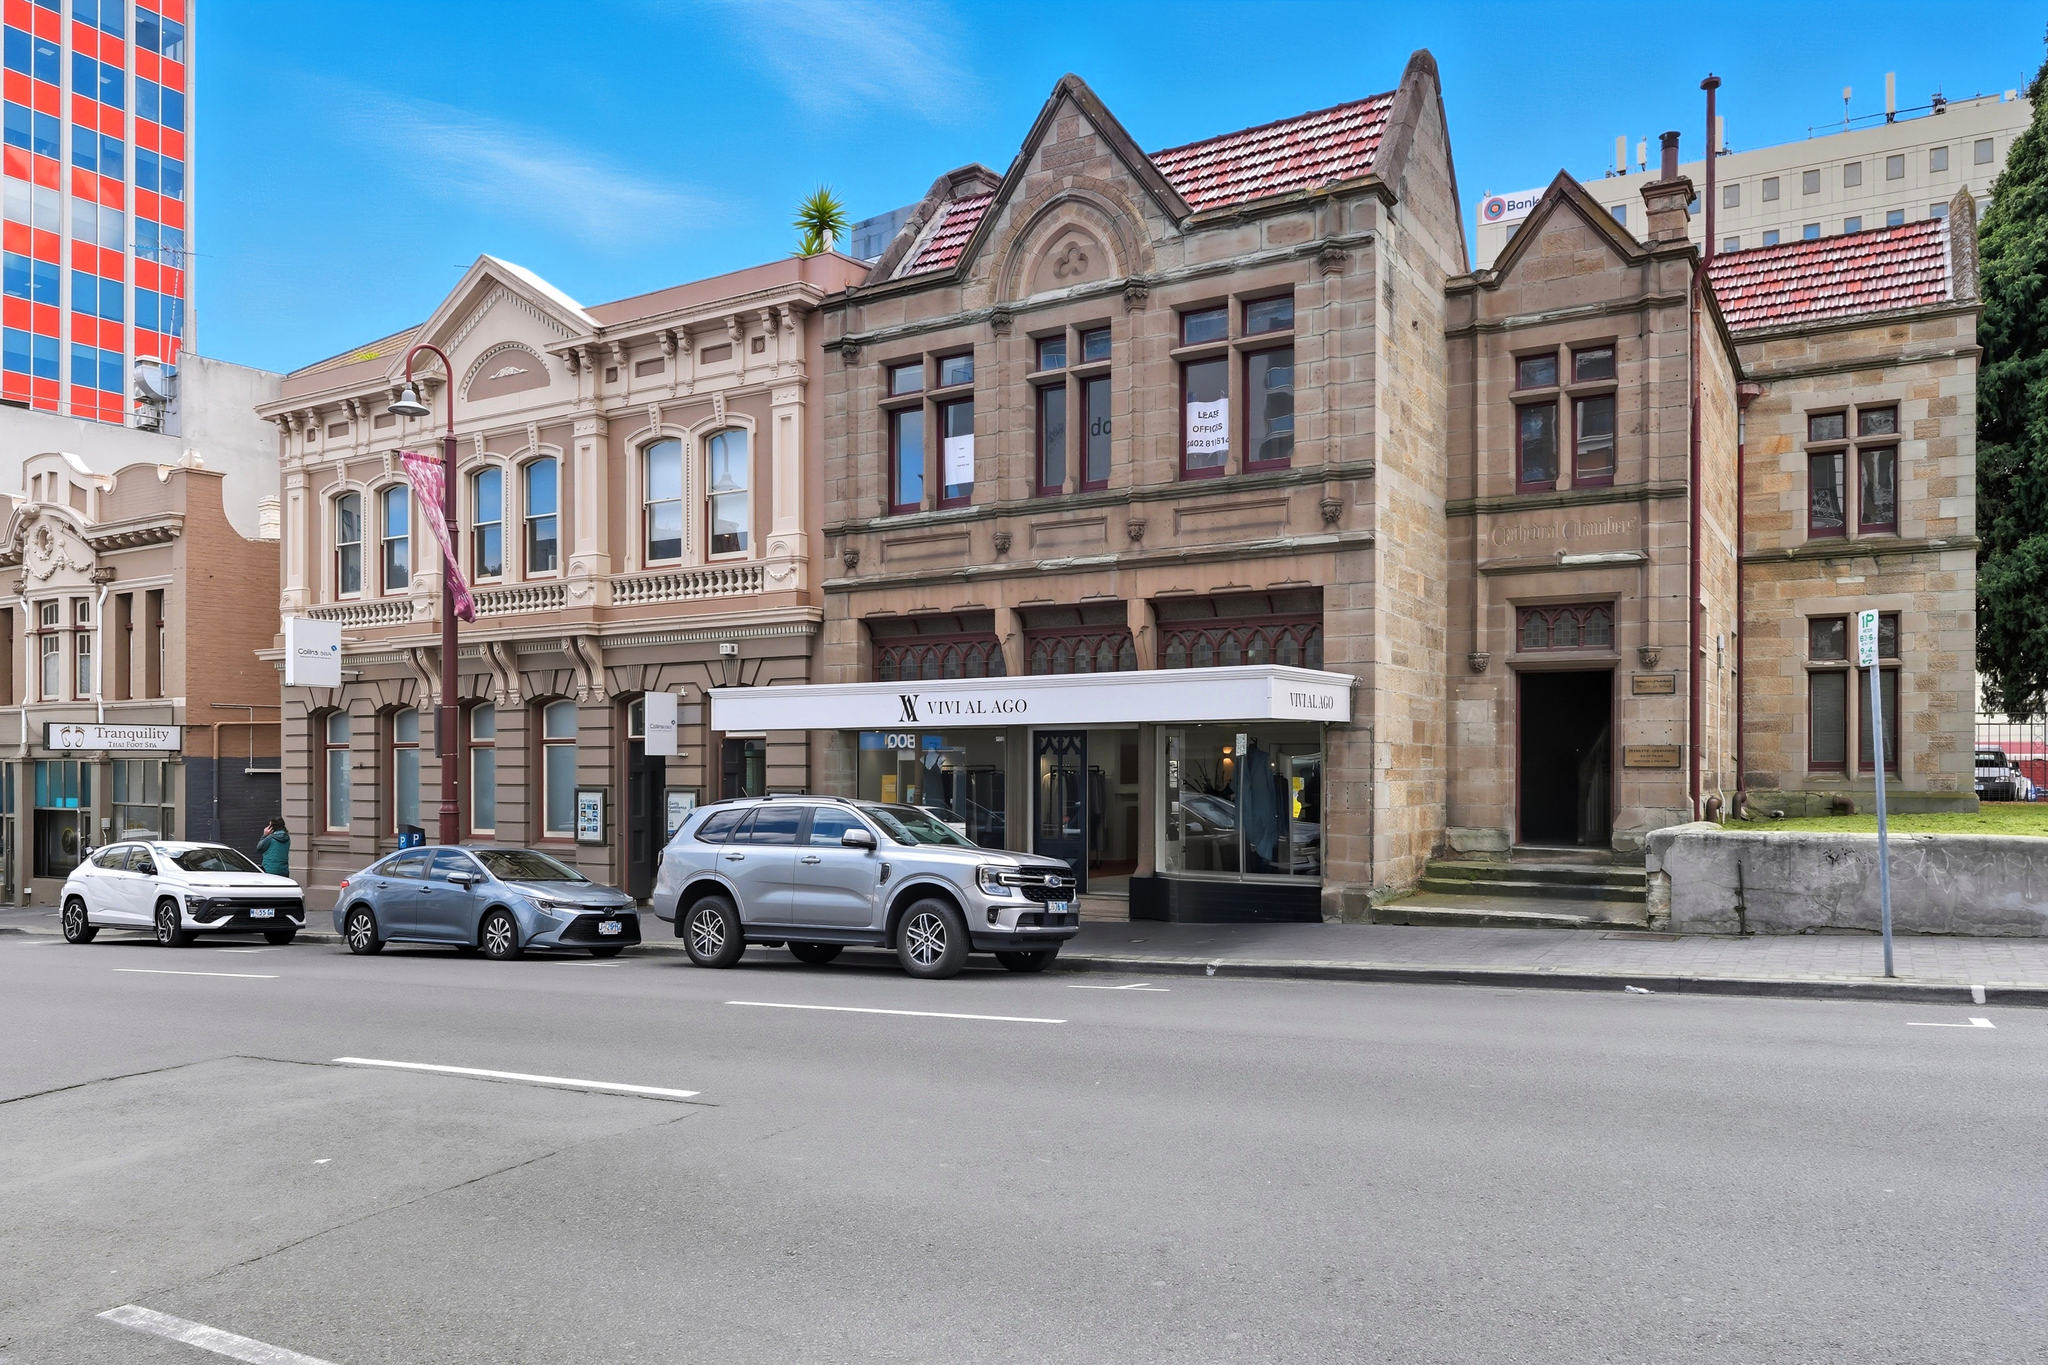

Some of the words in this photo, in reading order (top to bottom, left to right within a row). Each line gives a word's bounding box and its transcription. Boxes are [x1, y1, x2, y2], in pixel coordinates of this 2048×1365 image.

[1507, 196, 1540, 211] Bank
[927, 700, 960, 715] VIVI
[965, 700, 987, 714] AL
[991, 699, 1027, 714] AGO
[1290, 692, 1306, 707] VIVI
[1307, 694, 1317, 709] AL
[1318, 695, 1334, 709] AGO
[94, 726, 170, 741] Tranquility
[400, 836, 406, 846] P
[413, 833, 420, 845] P
